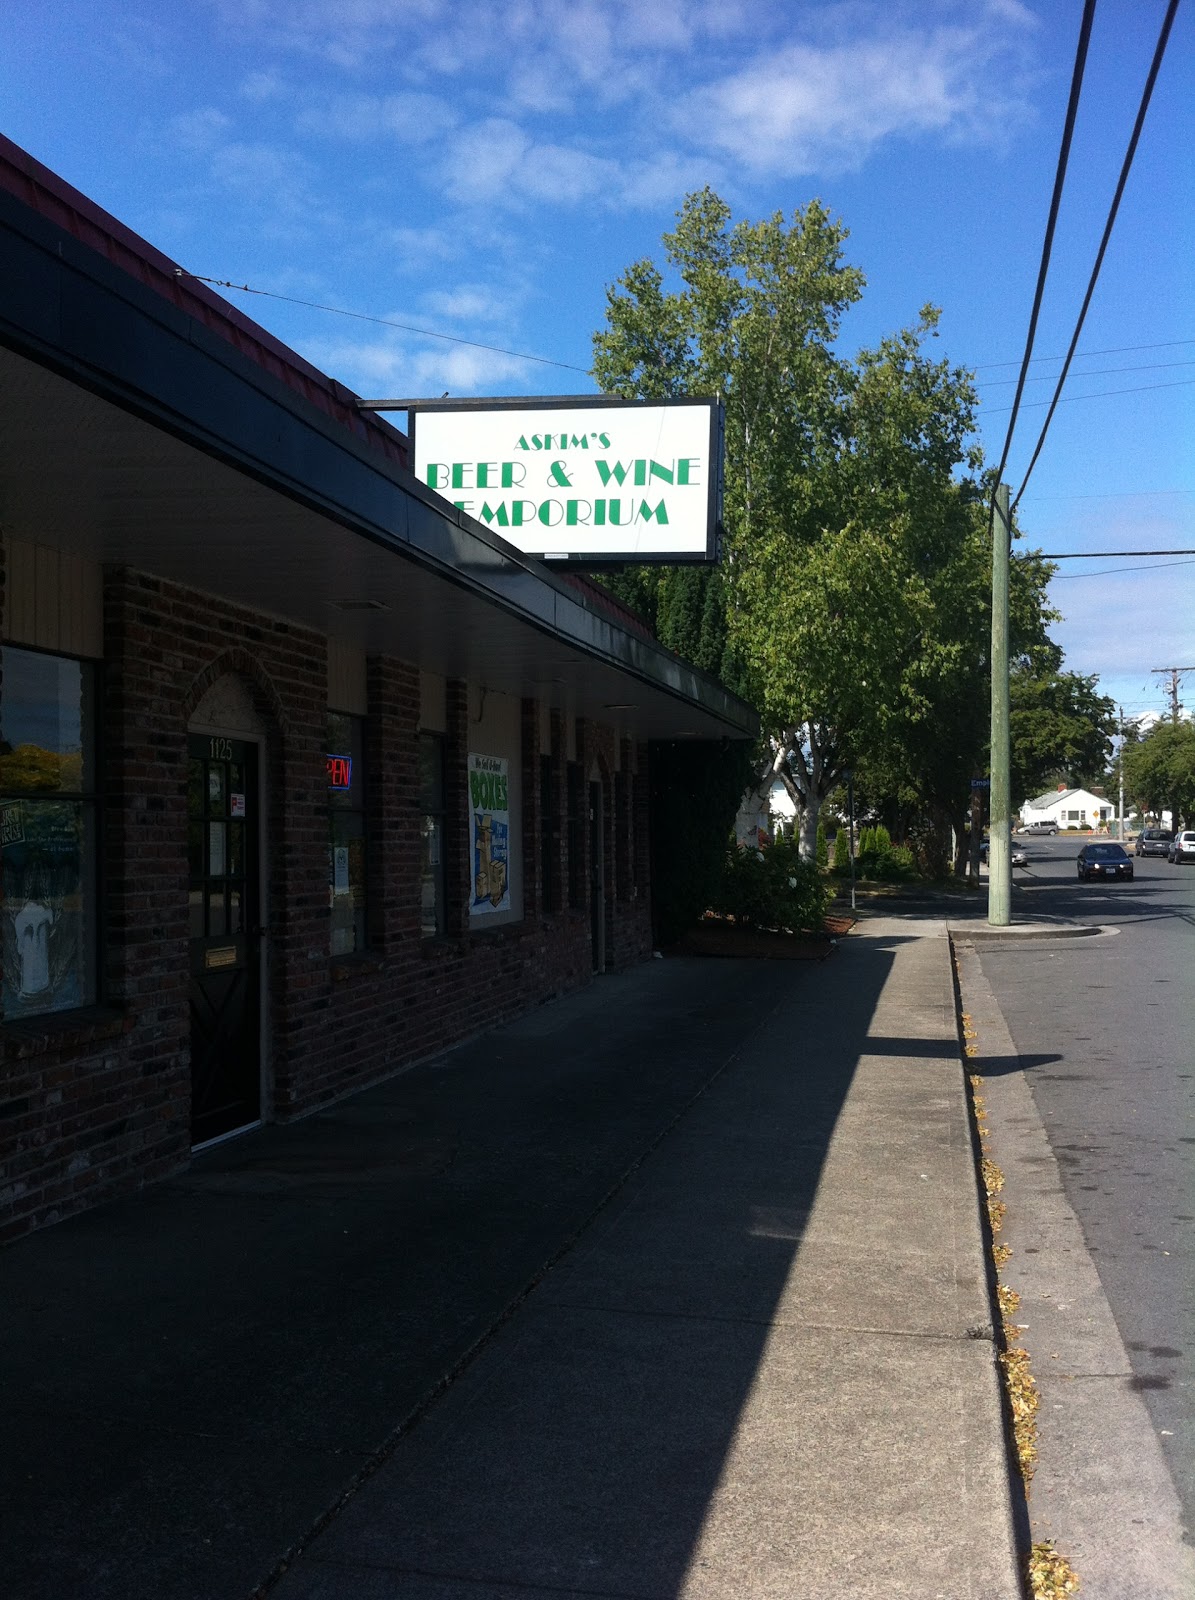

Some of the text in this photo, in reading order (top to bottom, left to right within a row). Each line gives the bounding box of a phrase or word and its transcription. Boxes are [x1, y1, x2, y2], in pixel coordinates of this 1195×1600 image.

[513, 432, 611, 451] ASKIM'S
[427, 458, 701, 490] BEER & WINE
[210, 737, 233, 760] 1125
[326, 758, 350, 787] PEN
[471, 770, 508, 811] BOXES
